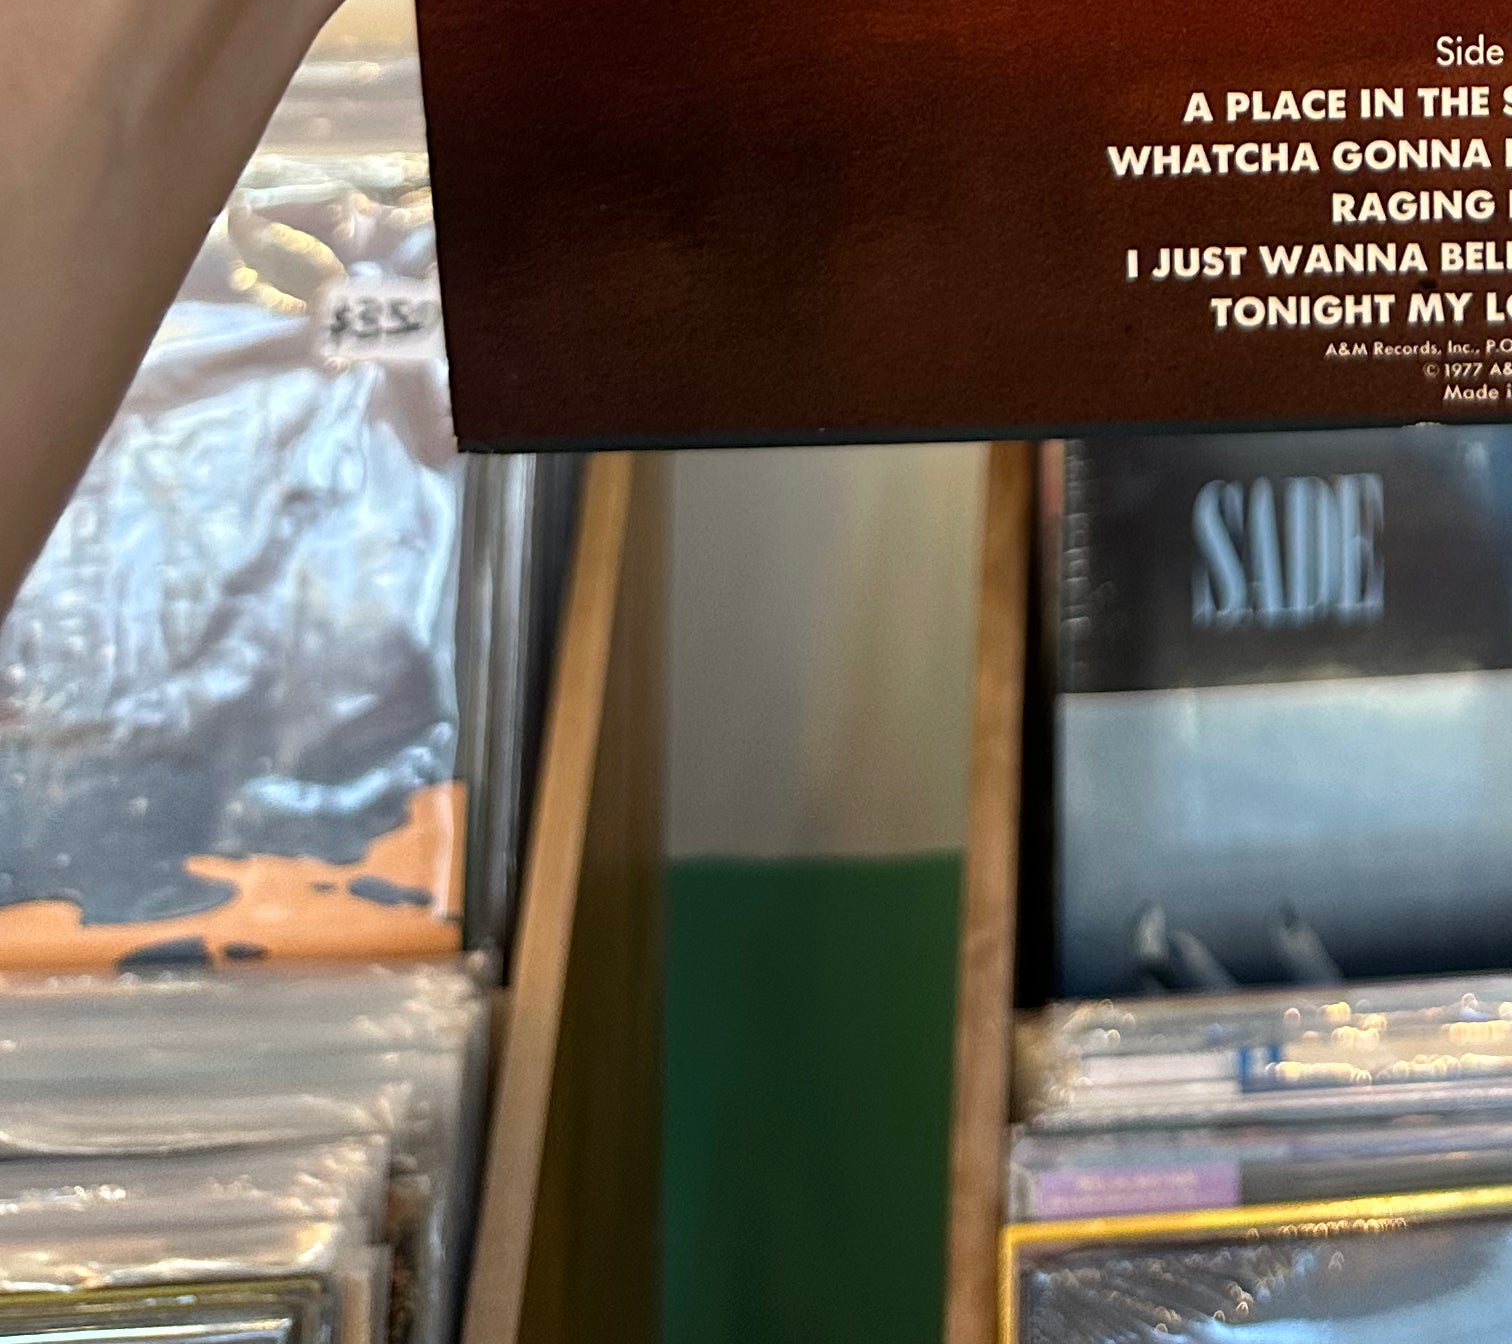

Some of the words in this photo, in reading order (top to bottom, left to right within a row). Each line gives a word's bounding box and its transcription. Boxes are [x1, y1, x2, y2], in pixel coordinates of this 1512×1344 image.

[1436, 33, 1505, 68] Side
[1182, 91, 1214, 124] A
[1226, 88, 1347, 124] PLACE
[1360, 87, 1404, 121] IN
[1416, 85, 1490, 120] THE
[1106, 142, 1320, 178] WHATCHA
[1331, 138, 1492, 174] GONNA
[1331, 189, 1496, 225] RAGING
[1126, 248, 1139, 280] I
[1151, 246, 1248, 280] JUST
[1258, 242, 1429, 278] WANNA
[1209, 294, 1396, 330] TONIGHT
[1407, 292, 1473, 326] MY
[1325, 341, 1369, 356] A&M
[1373, 339, 1443, 356] Records,
[1447, 339, 1481, 355] Inc.,
[1443, 361, 1484, 377] 1977
[1442, 383, 1500, 400] Made
[1191, 472, 1385, 631] SADE
